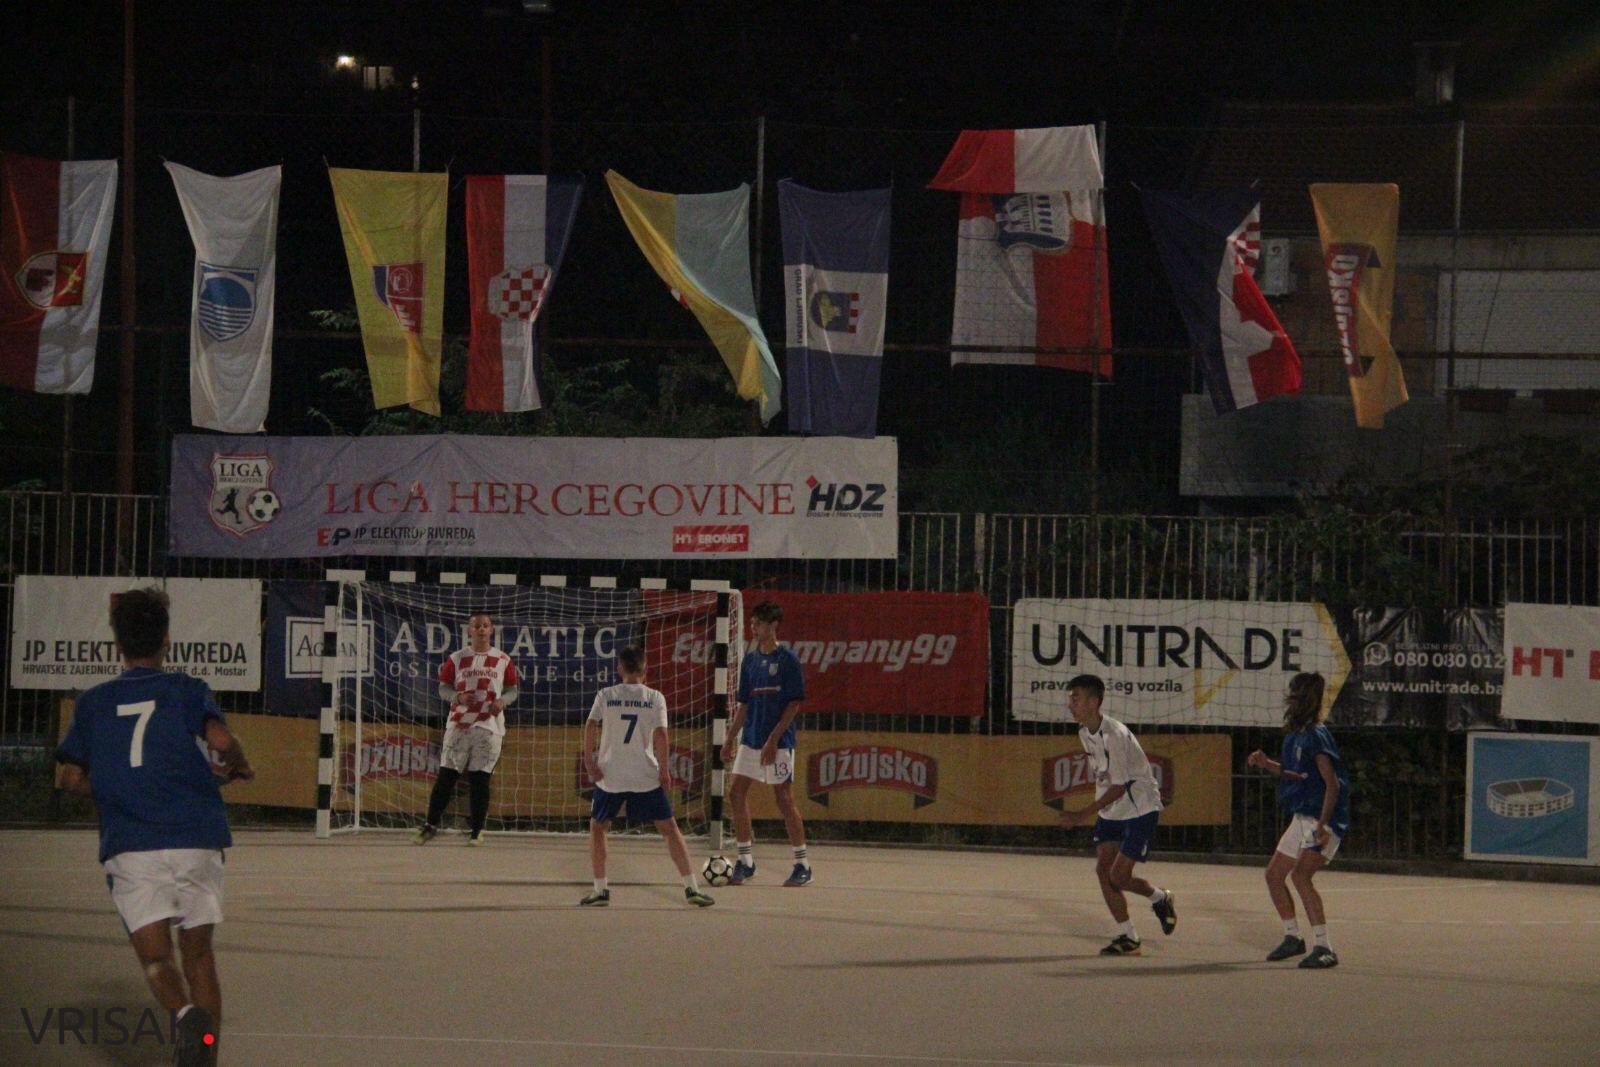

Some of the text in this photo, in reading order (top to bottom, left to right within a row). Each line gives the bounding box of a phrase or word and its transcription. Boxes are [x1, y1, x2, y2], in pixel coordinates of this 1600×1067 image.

[219, 462, 262, 477] LIGA
[324, 480, 795, 517] LIGA HERCEGOVINE
[807, 482, 888, 511] HDZ
[316, 527, 351, 547] EP
[353, 526, 367, 539] JP
[674, 533, 745, 545] HT ERONET
[22, 640, 46, 663] JP
[1031, 623, 1303, 672] UNITRADE
[1393, 651, 1504, 669] 080 080 012
[1512, 646, 1564, 678] HT
[22, 664, 68, 675] HRVATSKE
[69, 664, 117, 675] ZAJEDNICE
[191, 665, 211, 676] d.d.
[214, 666, 248, 677] Mostar
[1137, 679, 1183, 692] vozila
[1362, 679, 1504, 696] www.unitrade.ba
[624, 700, 653, 709] STOLAC
[116, 699, 156, 769] 7
[620, 713, 638, 744] 7
[774, 761, 789, 777] 13
[818, 747, 928, 789] Ožujsko
